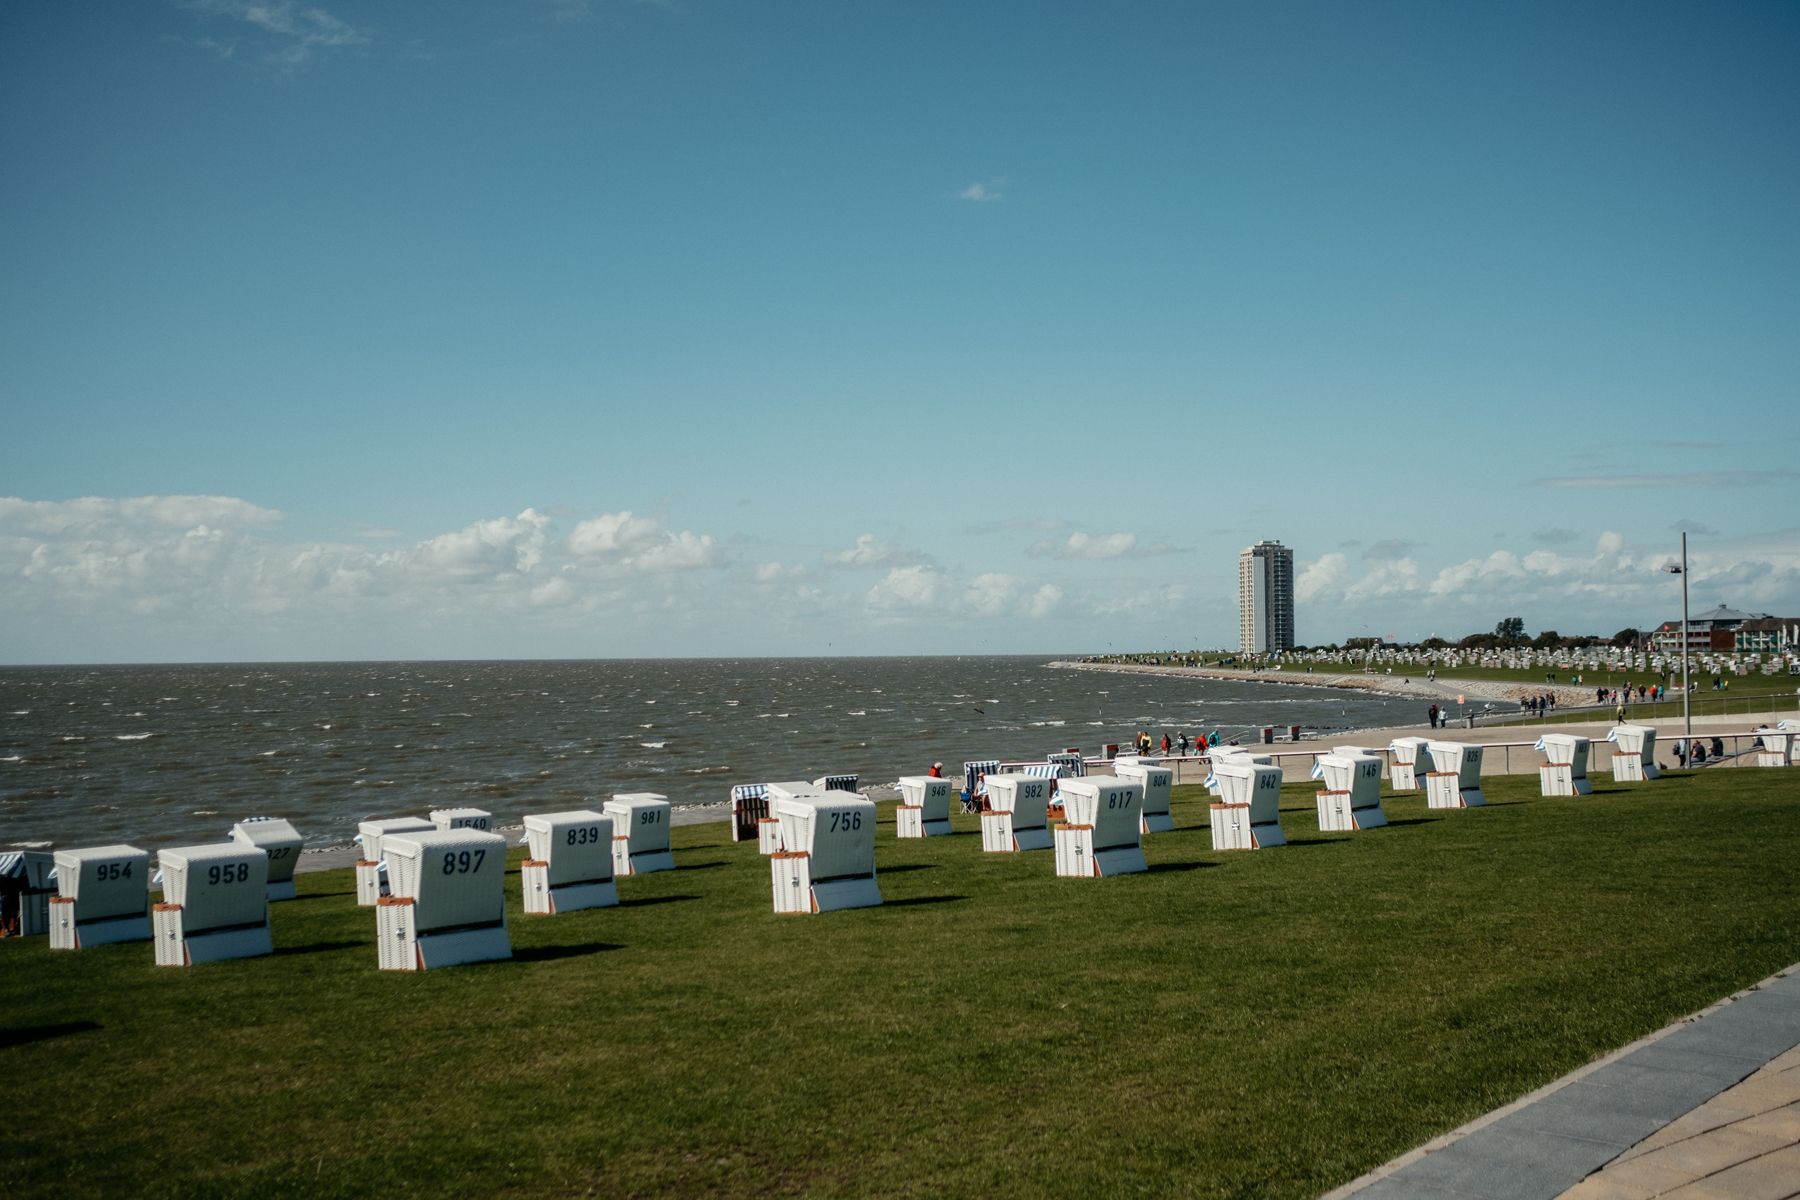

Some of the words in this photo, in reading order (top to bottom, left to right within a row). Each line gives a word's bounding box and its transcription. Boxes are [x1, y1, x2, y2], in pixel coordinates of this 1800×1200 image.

[1362, 763, 1377, 779] 146
[931, 785, 947, 797] 946
[1260, 774, 1277, 790] 842
[1024, 784, 1043, 799] 982
[1108, 791, 1133, 809] 817
[641, 810, 661, 824] 981
[830, 811, 862, 832] 756
[567, 826, 599, 846] 839
[442, 849, 486, 876] 897
[97, 861, 133, 883] 954
[208, 862, 249, 886] 958
